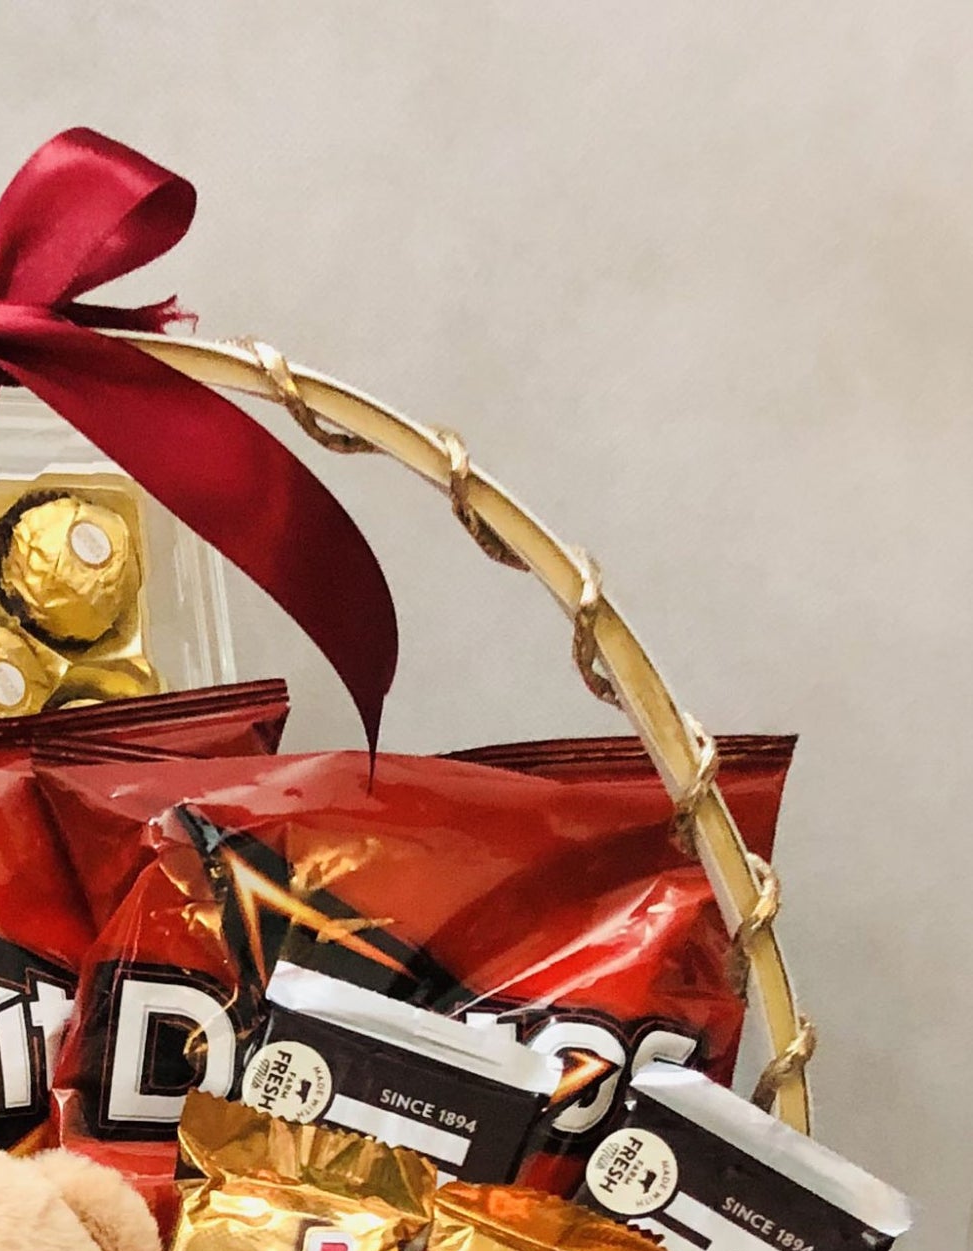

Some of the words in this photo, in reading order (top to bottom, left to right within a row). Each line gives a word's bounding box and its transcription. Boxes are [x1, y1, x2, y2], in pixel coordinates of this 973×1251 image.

[257, 1050, 293, 1110] FRESH
[380, 1088, 435, 1118] SINCE
[438, 1108, 477, 1133] 1894
[598, 1136, 644, 1194] FRESH
[722, 1196, 775, 1235] SINCE
